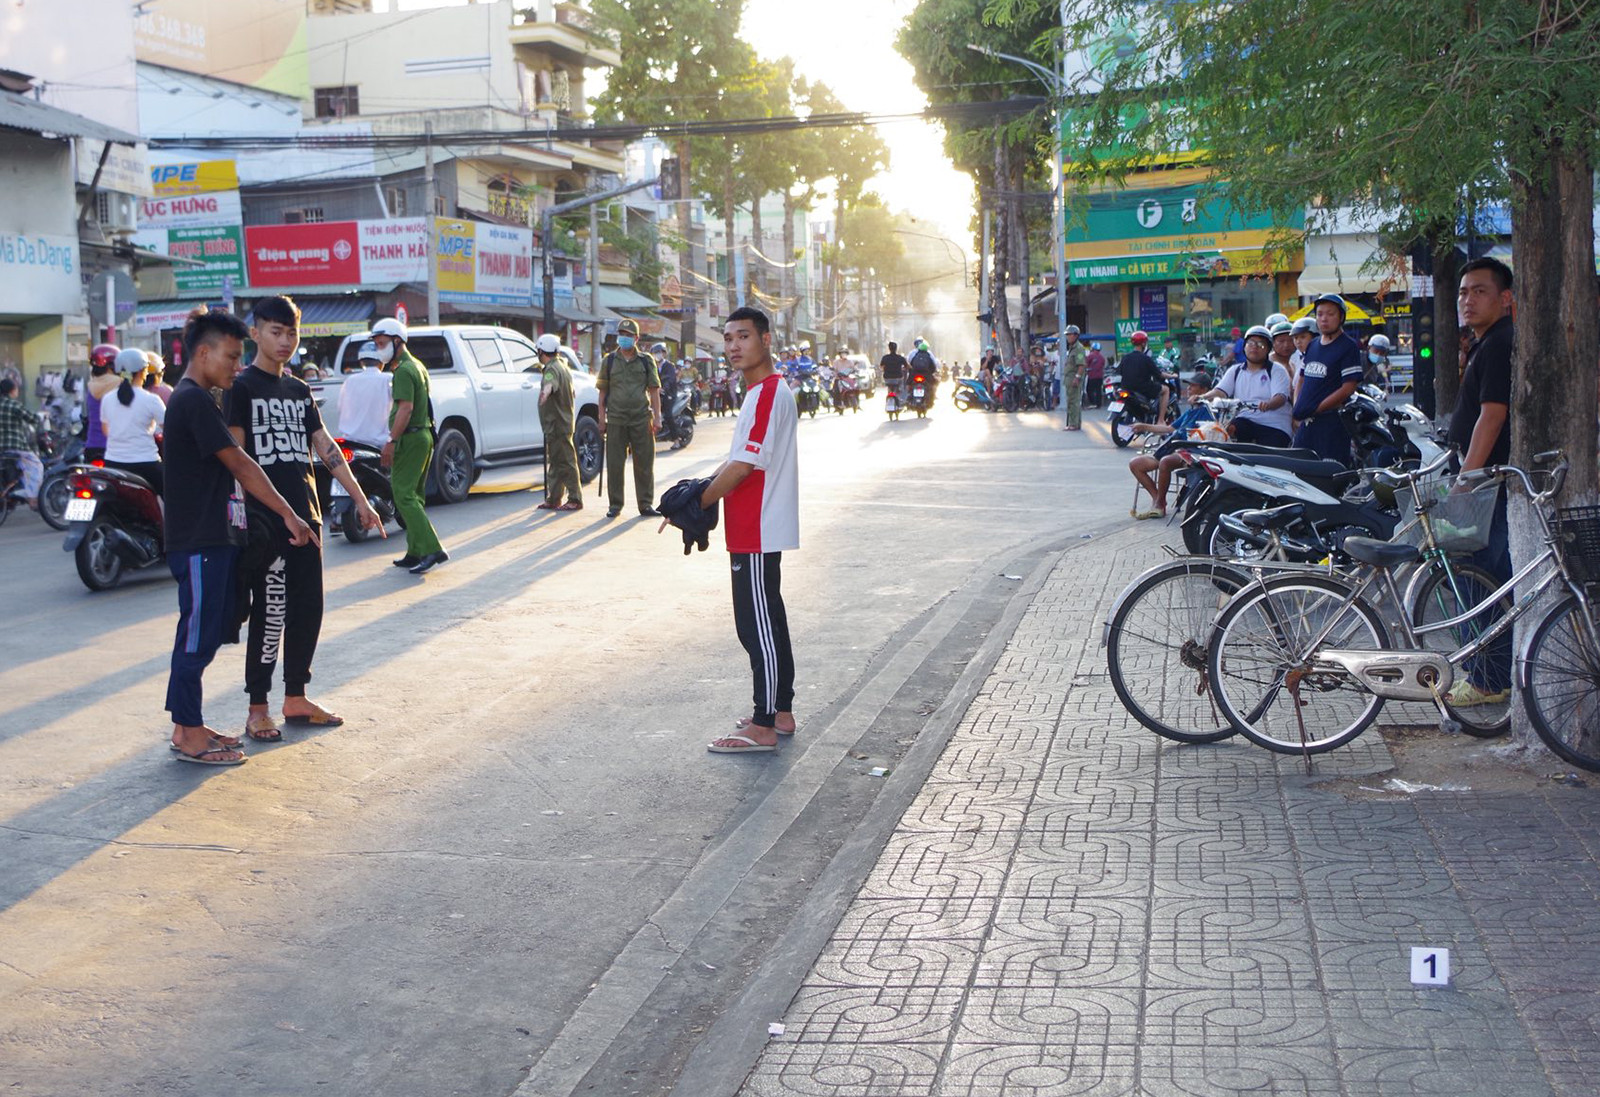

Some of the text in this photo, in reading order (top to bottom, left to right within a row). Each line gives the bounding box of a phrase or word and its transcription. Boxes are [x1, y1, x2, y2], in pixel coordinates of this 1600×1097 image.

[171, 197, 218, 215] HƯNG
[289, 248, 330, 263] quang
[362, 243, 404, 260] THANH
[479, 250, 512, 277] THANH
[1074, 267, 1088, 279] VAY
[1090, 265, 1119, 277] NHANH
[1157, 262, 1169, 273] XE
[1117, 321, 1139, 334] VAY
[1423, 953, 1437, 979] 1
